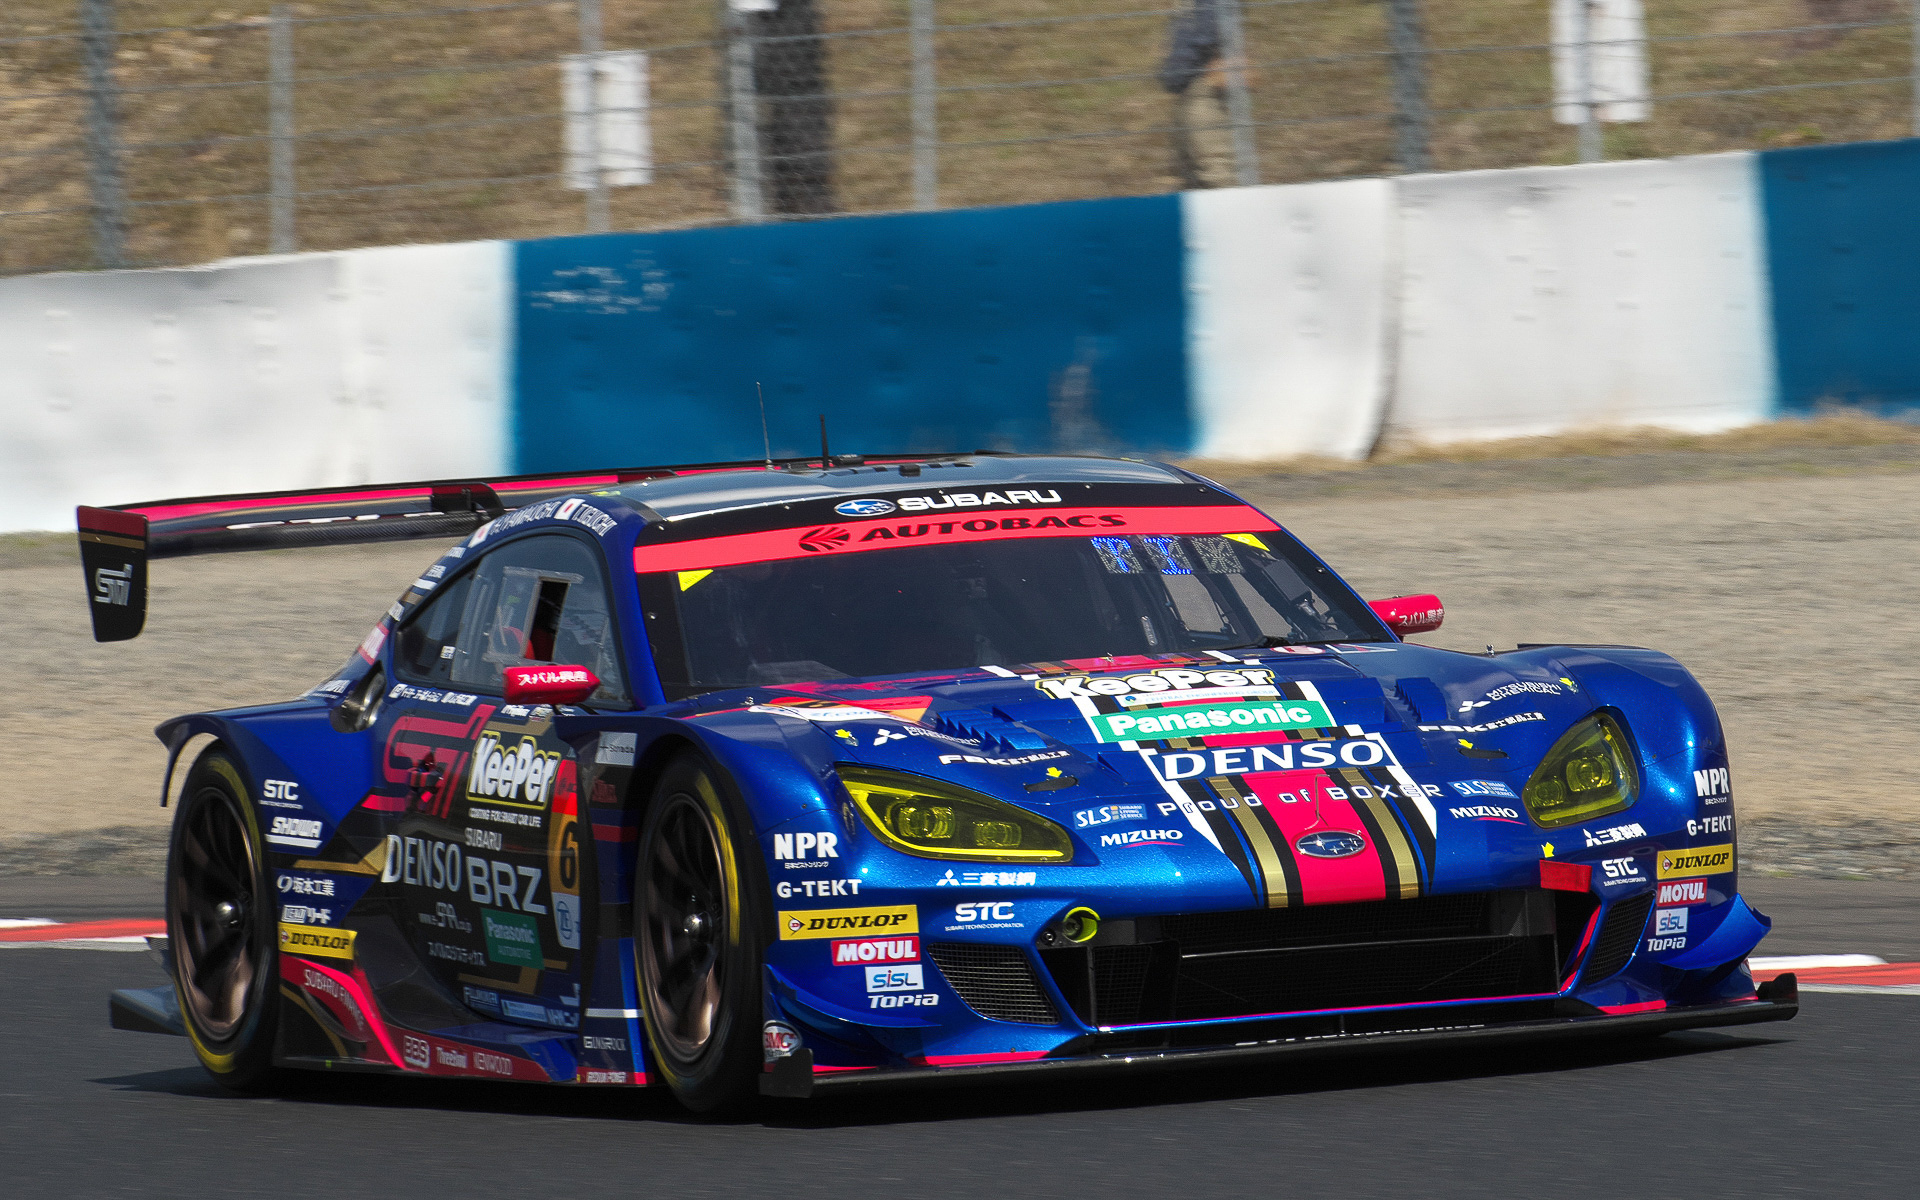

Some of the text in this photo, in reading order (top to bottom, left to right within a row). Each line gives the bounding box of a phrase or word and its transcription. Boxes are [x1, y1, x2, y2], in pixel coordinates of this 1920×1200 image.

[897, 489, 1062, 511] SUBARU
[859, 514, 1127, 542] AUTOBACS
[1040, 669, 1272, 700] KeePer
[1106, 703, 1313, 737] Panasonic
[469, 736, 558, 803] KeePer
[1163, 740, 1386, 781] DENSO
[263, 778, 299, 801] STC
[1453, 780, 1490, 795] SLS
[1693, 767, 1730, 797] NPR
[1157, 784, 1444, 817] Proud of BOXER
[1449, 805, 1519, 819] MIZUHO
[1076, 806, 1112, 828] SLS
[1686, 814, 1733, 836] G-TEKT
[465, 827, 502, 851] SUBARU
[774, 831, 840, 860] NPR
[1100, 829, 1183, 848] MIZUHO
[381, 834, 462, 892] DENSO
[1601, 856, 1639, 878] STC
[1673, 852, 1730, 870] DUNLOP
[466, 856, 547, 914] BRZ
[776, 878, 863, 899] G-TEKT
[1659, 881, 1705, 904] MOTUL
[807, 912, 908, 931] DUNLOP
[955, 901, 1015, 922] STC
[290, 932, 350, 950] DUNLOP
[486, 916, 536, 944] Panasonic
[836, 939, 918, 963] MOTUL
